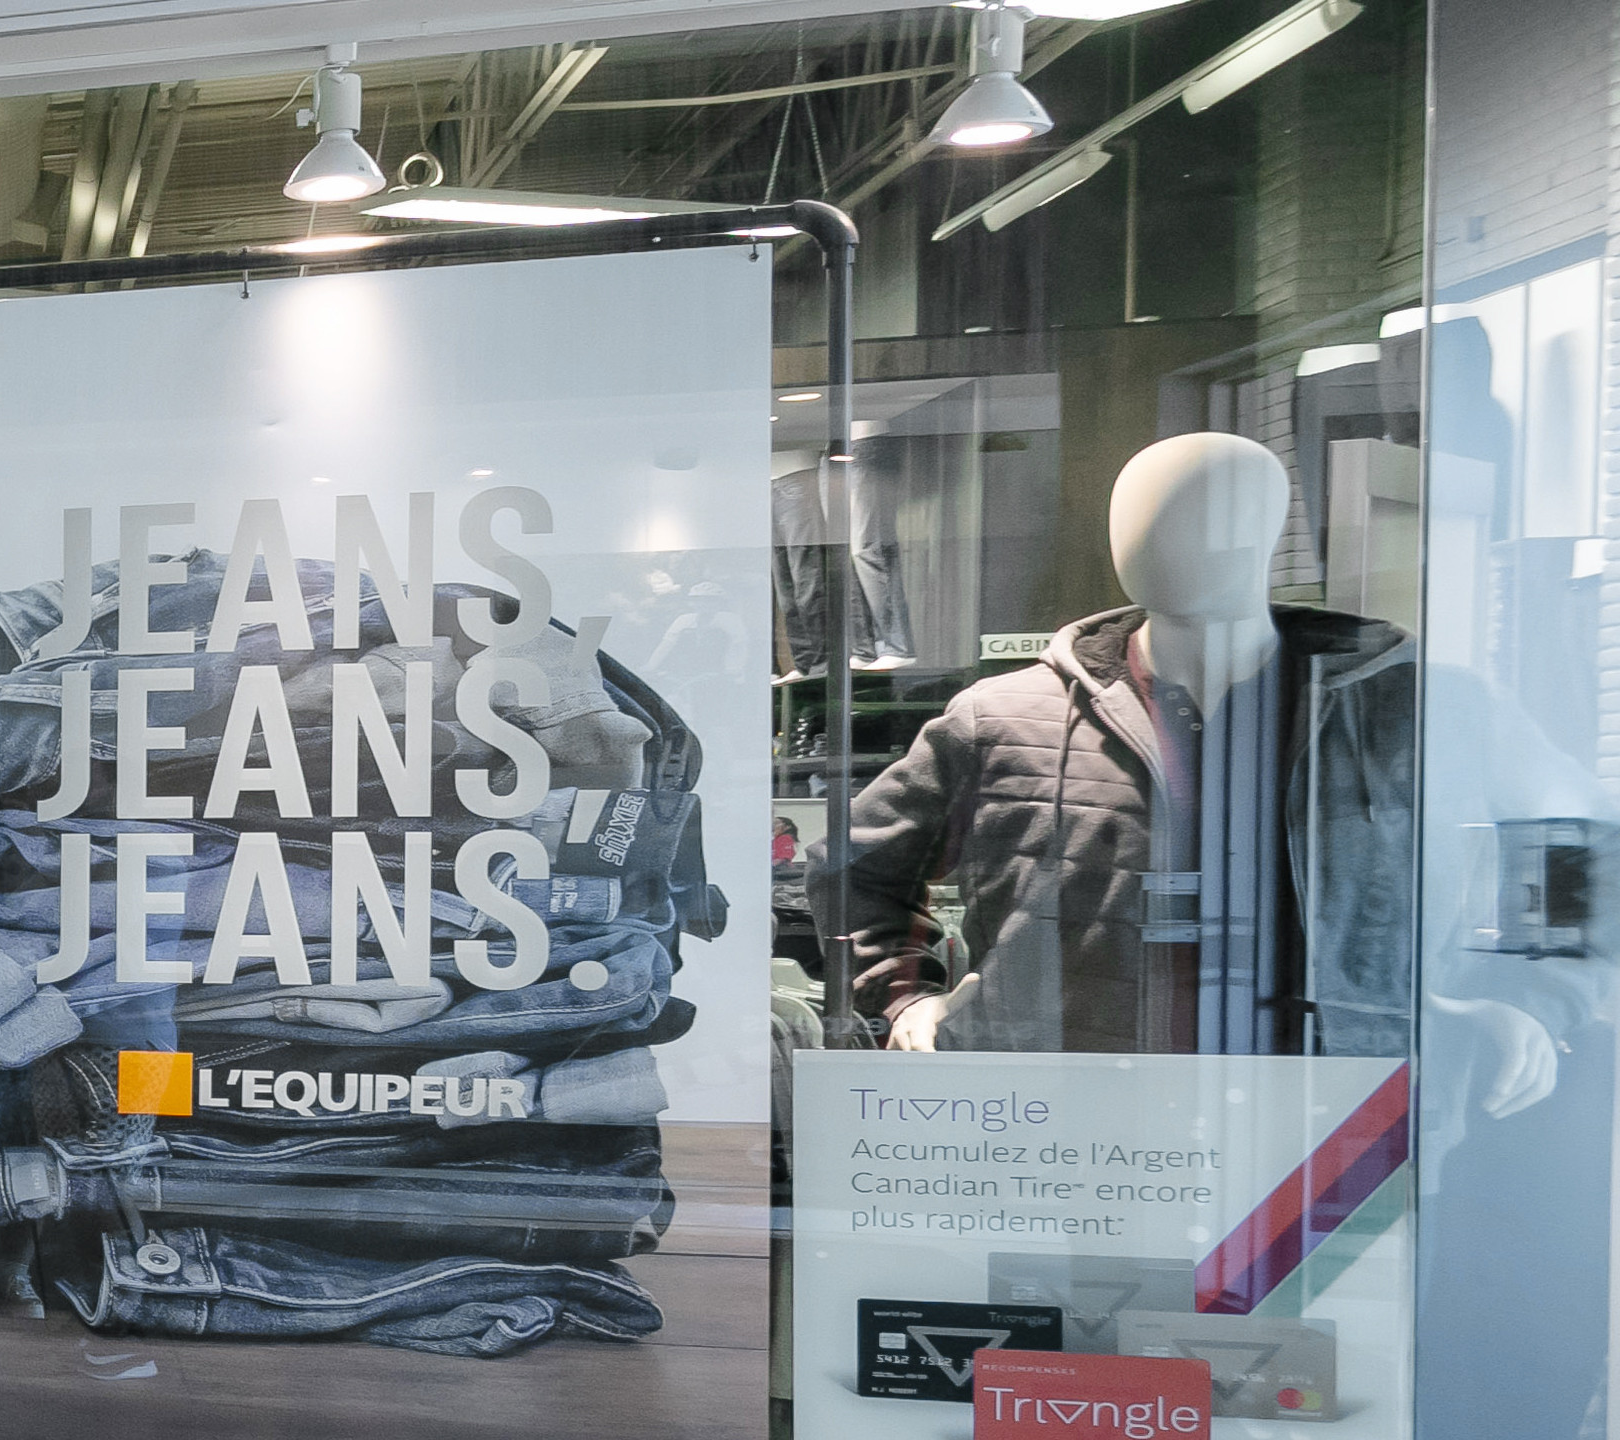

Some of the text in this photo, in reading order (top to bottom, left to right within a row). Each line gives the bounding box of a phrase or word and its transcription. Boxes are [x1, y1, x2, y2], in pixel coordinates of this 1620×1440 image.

[38, 485, 613, 666] JEANS,
[37, 657, 611, 844] JEANS,
[35, 829, 609, 992] JEANS.
[849, 1088, 1051, 1132] Triangle
[850, 1138, 1221, 1173] Accumulez de l'Argent
[850, 1172, 998, 1197] Canadian
[1095, 1182, 1212, 1204] encore
[851, 1206, 915, 1232] plus
[982, 1386, 1200, 1440] Triangle
